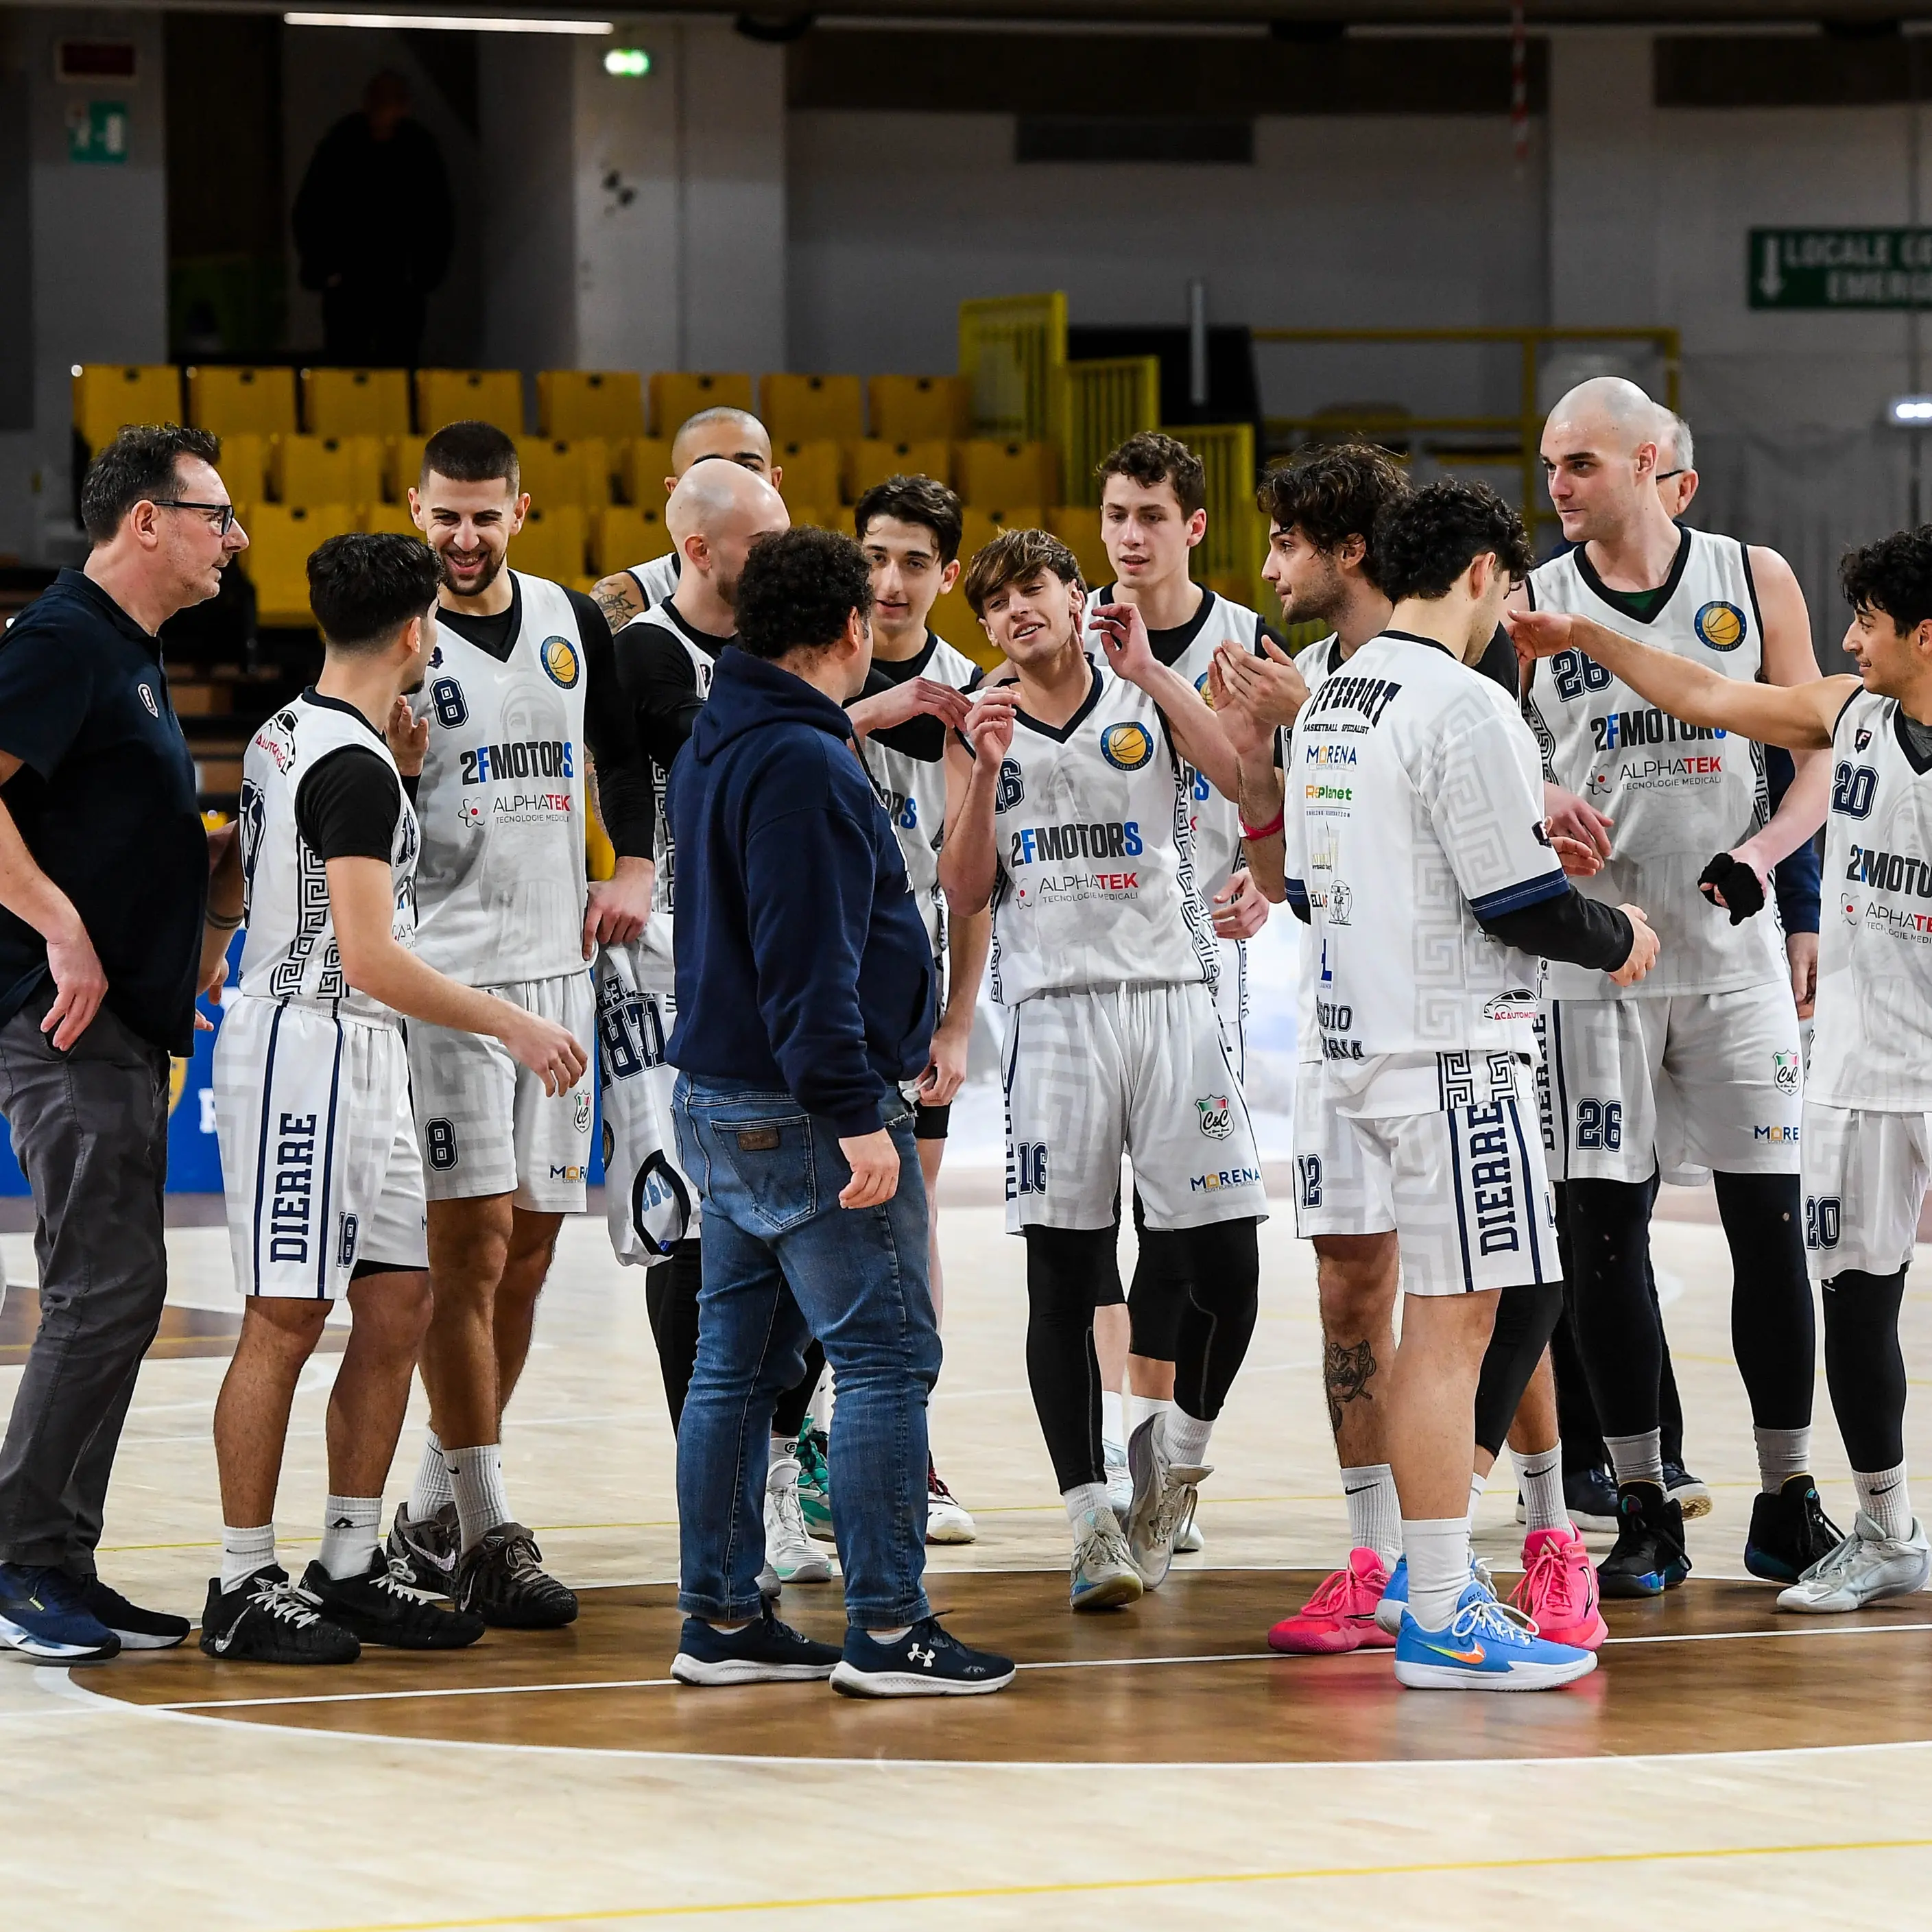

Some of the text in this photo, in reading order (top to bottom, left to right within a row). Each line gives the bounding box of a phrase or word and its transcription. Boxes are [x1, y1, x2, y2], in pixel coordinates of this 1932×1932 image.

[1550, 647, 1612, 702] 26
[429, 676, 469, 729] 8
[460, 741, 574, 785] 2FMOTORS
[1619, 756, 1722, 781] ALPHATEK
[1622, 778, 1680, 791] TECNOLOGIE
[493, 794, 571, 813] ALPHATEK
[1832, 760, 1880, 820] 20
[496, 814, 544, 824] TECNOLOGIE
[1011, 822, 1143, 868] 2FMOTORS
[1039, 872, 1139, 894] ALPHATEK
[1042, 892, 1097, 903] TECNOLOGIE
[425, 1117, 459, 1171] 8
[1575, 1098, 1622, 1153] 26
[270, 1112, 318, 1264] DIERRE
[1018, 1142, 1049, 1196] 16
[1467, 1100, 1519, 1257] DIERRE
[1805, 1195, 1841, 1250] 20
